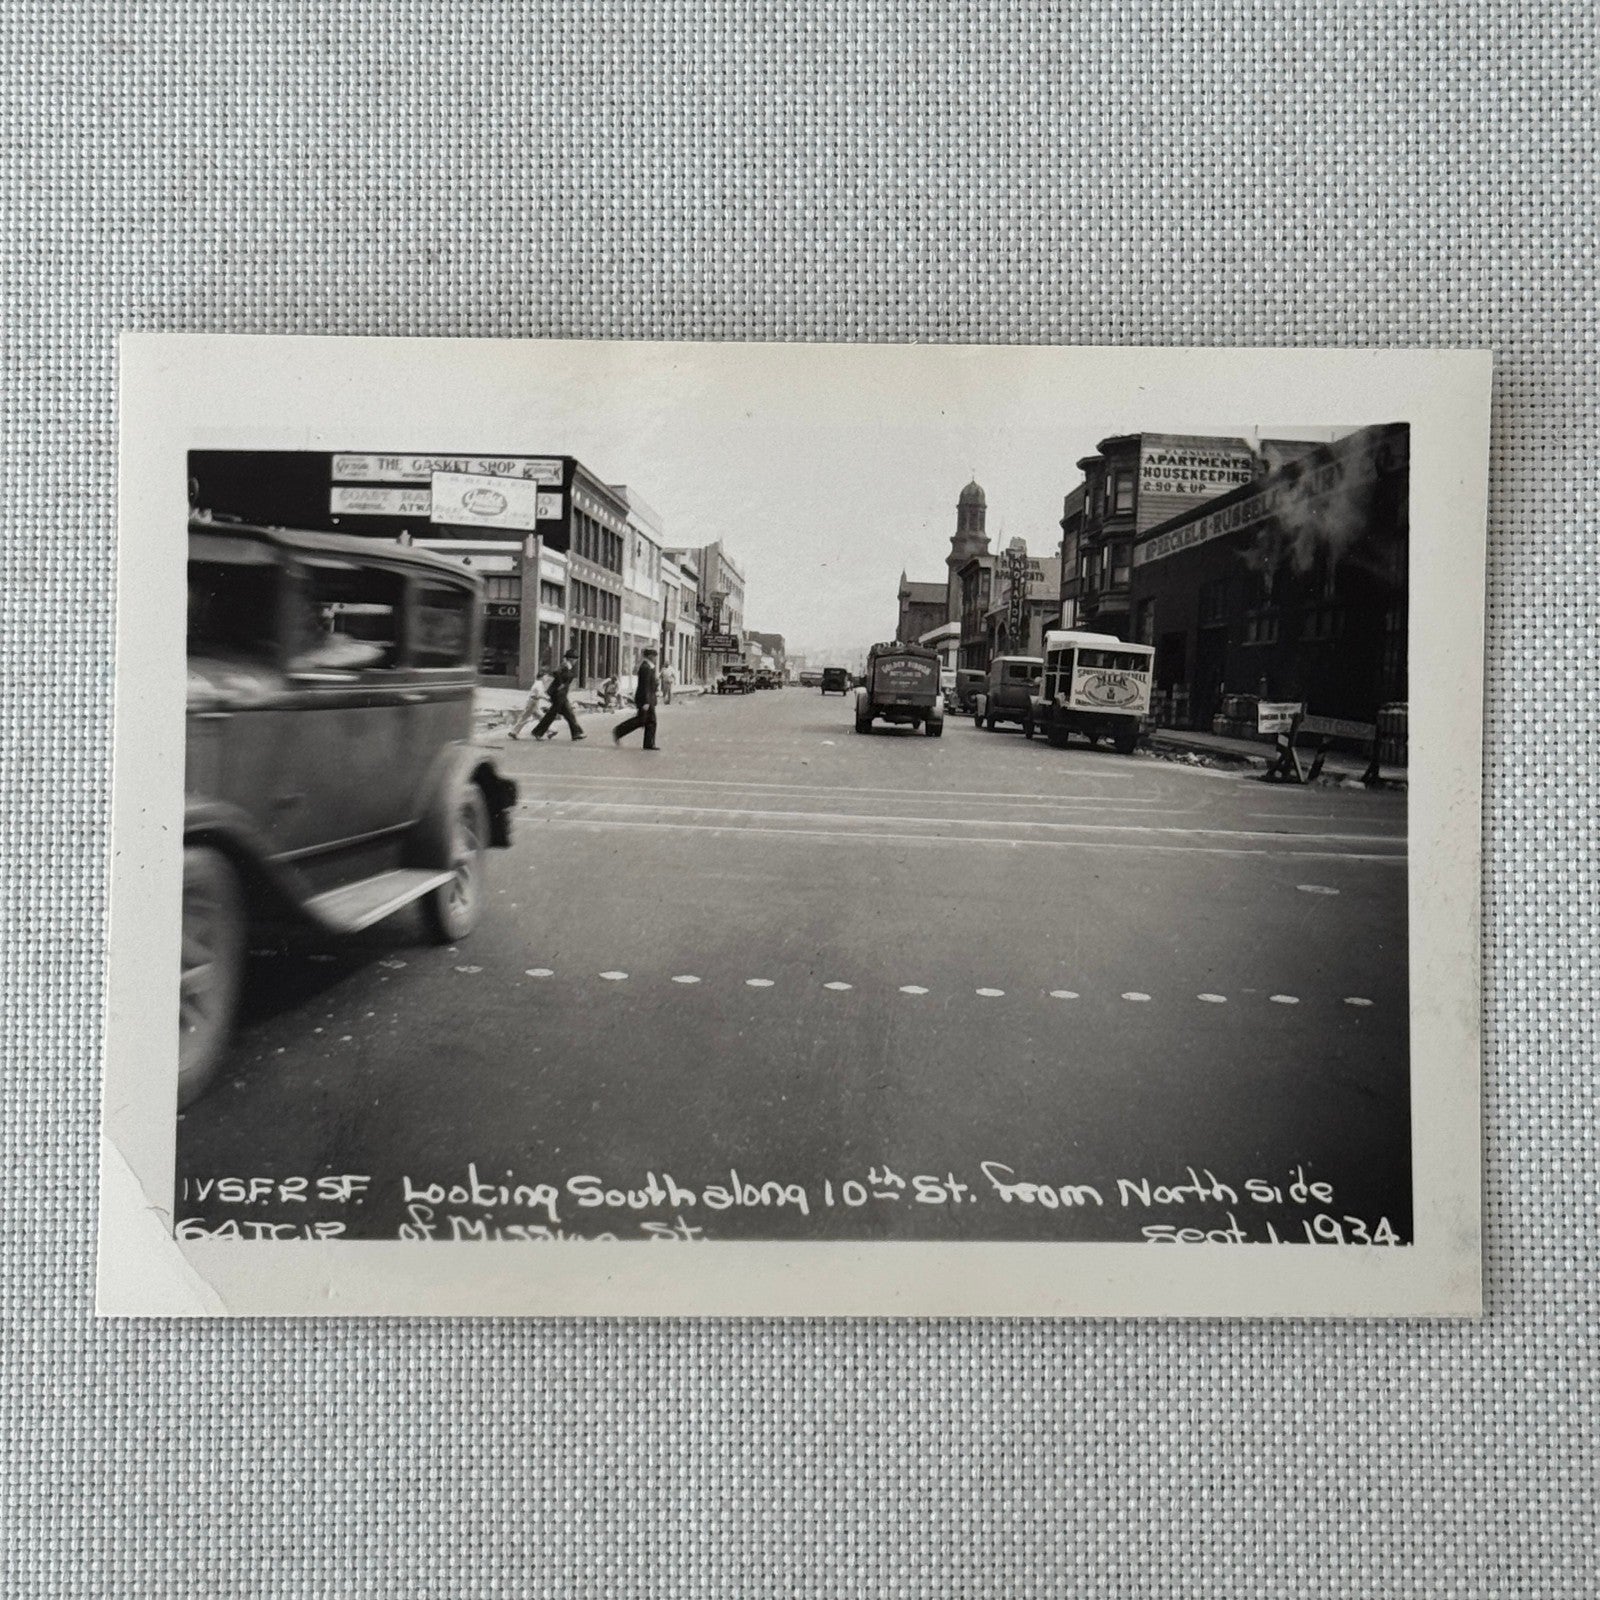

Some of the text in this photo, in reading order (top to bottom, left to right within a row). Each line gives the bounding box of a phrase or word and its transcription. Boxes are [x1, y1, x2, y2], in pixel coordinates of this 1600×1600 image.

[377, 457, 402, 471] THE
[478, 462, 516, 474] SHOP
[1144, 454, 1251, 469] APARTMENTS
[1143, 467, 1250, 484] HOUSEKEEPING
[402, 1162, 561, 1223] Looking
[566, 1170, 697, 1208] South
[702, 1168, 809, 1216] along
[912, 1171, 977, 1204] St.
[981, 1161, 1104, 1209] from
[1116, 1165, 1239, 1208] North
[1244, 1164, 1334, 1205] Side
[400, 1204, 437, 1241] of
